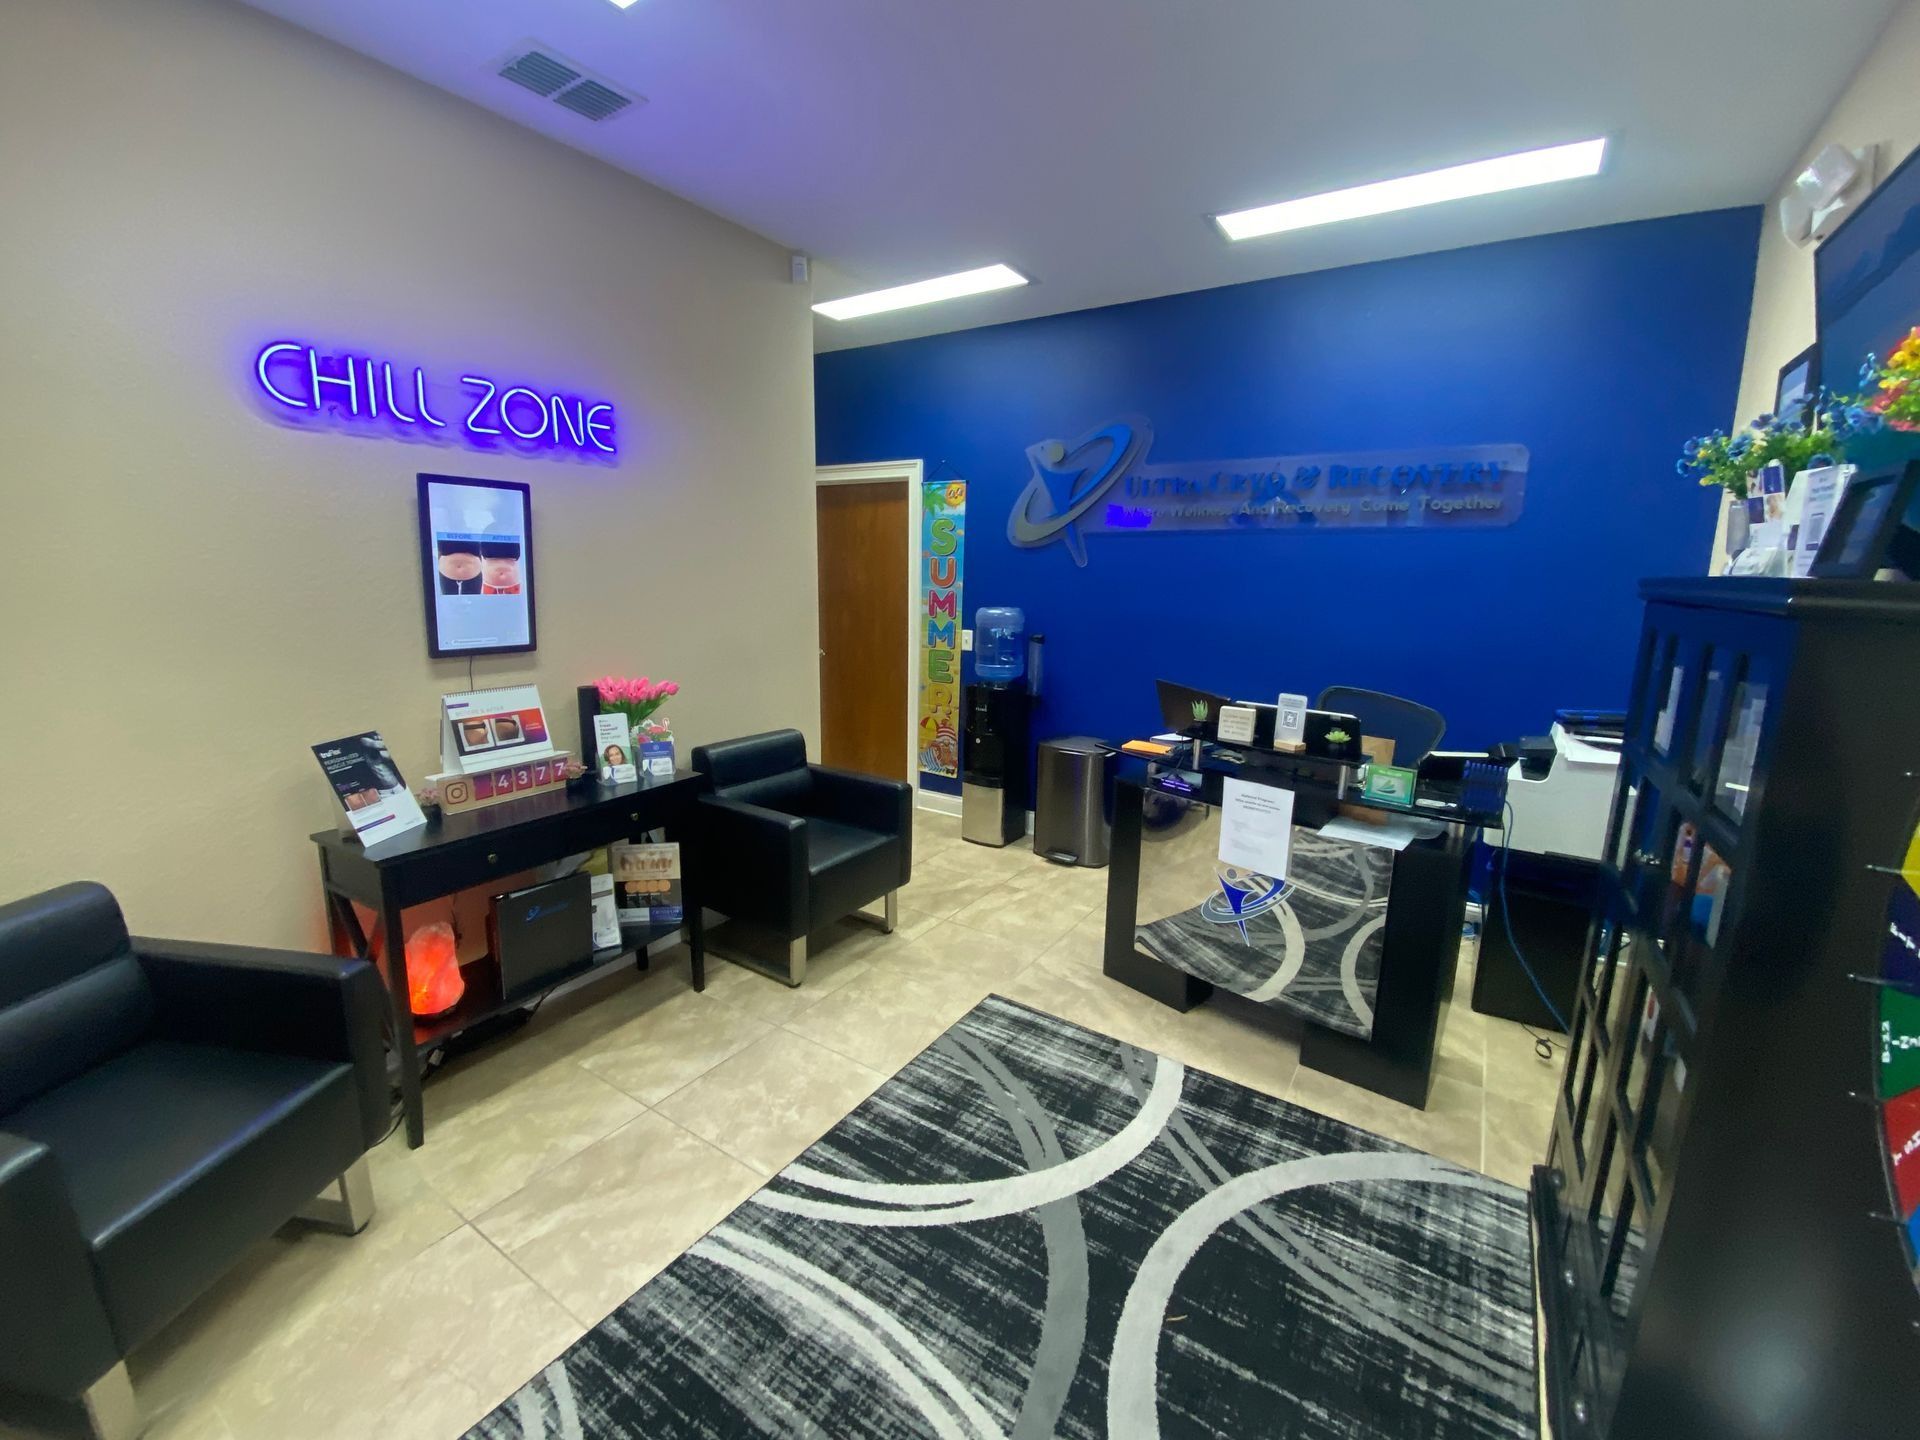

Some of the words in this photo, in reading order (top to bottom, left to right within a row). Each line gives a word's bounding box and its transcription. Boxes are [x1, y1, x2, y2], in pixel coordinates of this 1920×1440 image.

[257, 342, 447, 428] CHILL
[461, 376, 616, 452] ZONE
[1240, 501, 1272, 516] And
[1275, 499, 1351, 517] Recovery
[1360, 497, 1410, 513] Come
[1418, 494, 1503, 515] Together
[1292, 465, 1322, 490] &
[1328, 460, 1509, 490] RECOVERY
[927, 517, 958, 716] SUMMER
